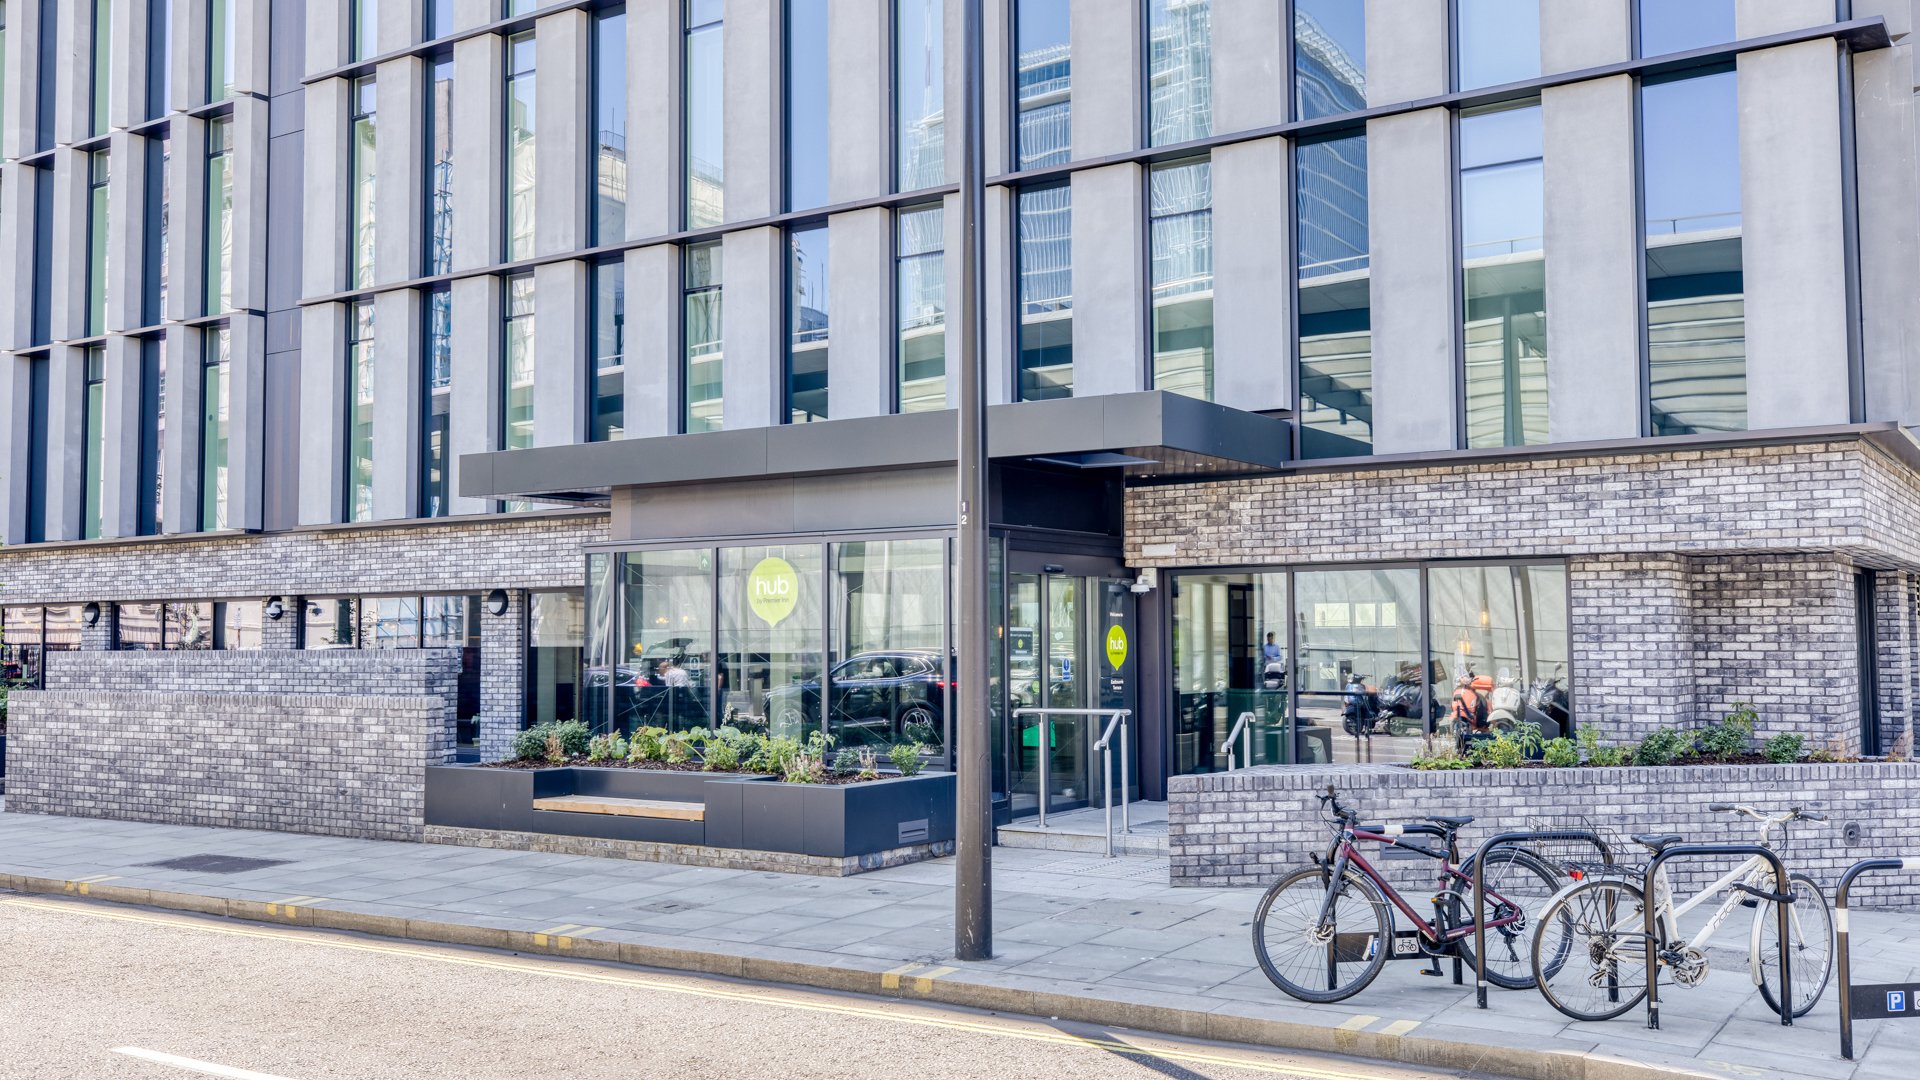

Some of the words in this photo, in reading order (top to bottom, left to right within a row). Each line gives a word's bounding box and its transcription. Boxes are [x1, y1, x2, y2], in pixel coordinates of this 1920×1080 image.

[755, 575, 789, 596] hub
[1109, 636, 1124, 650] hub
[1890, 993, 1901, 1009] P
